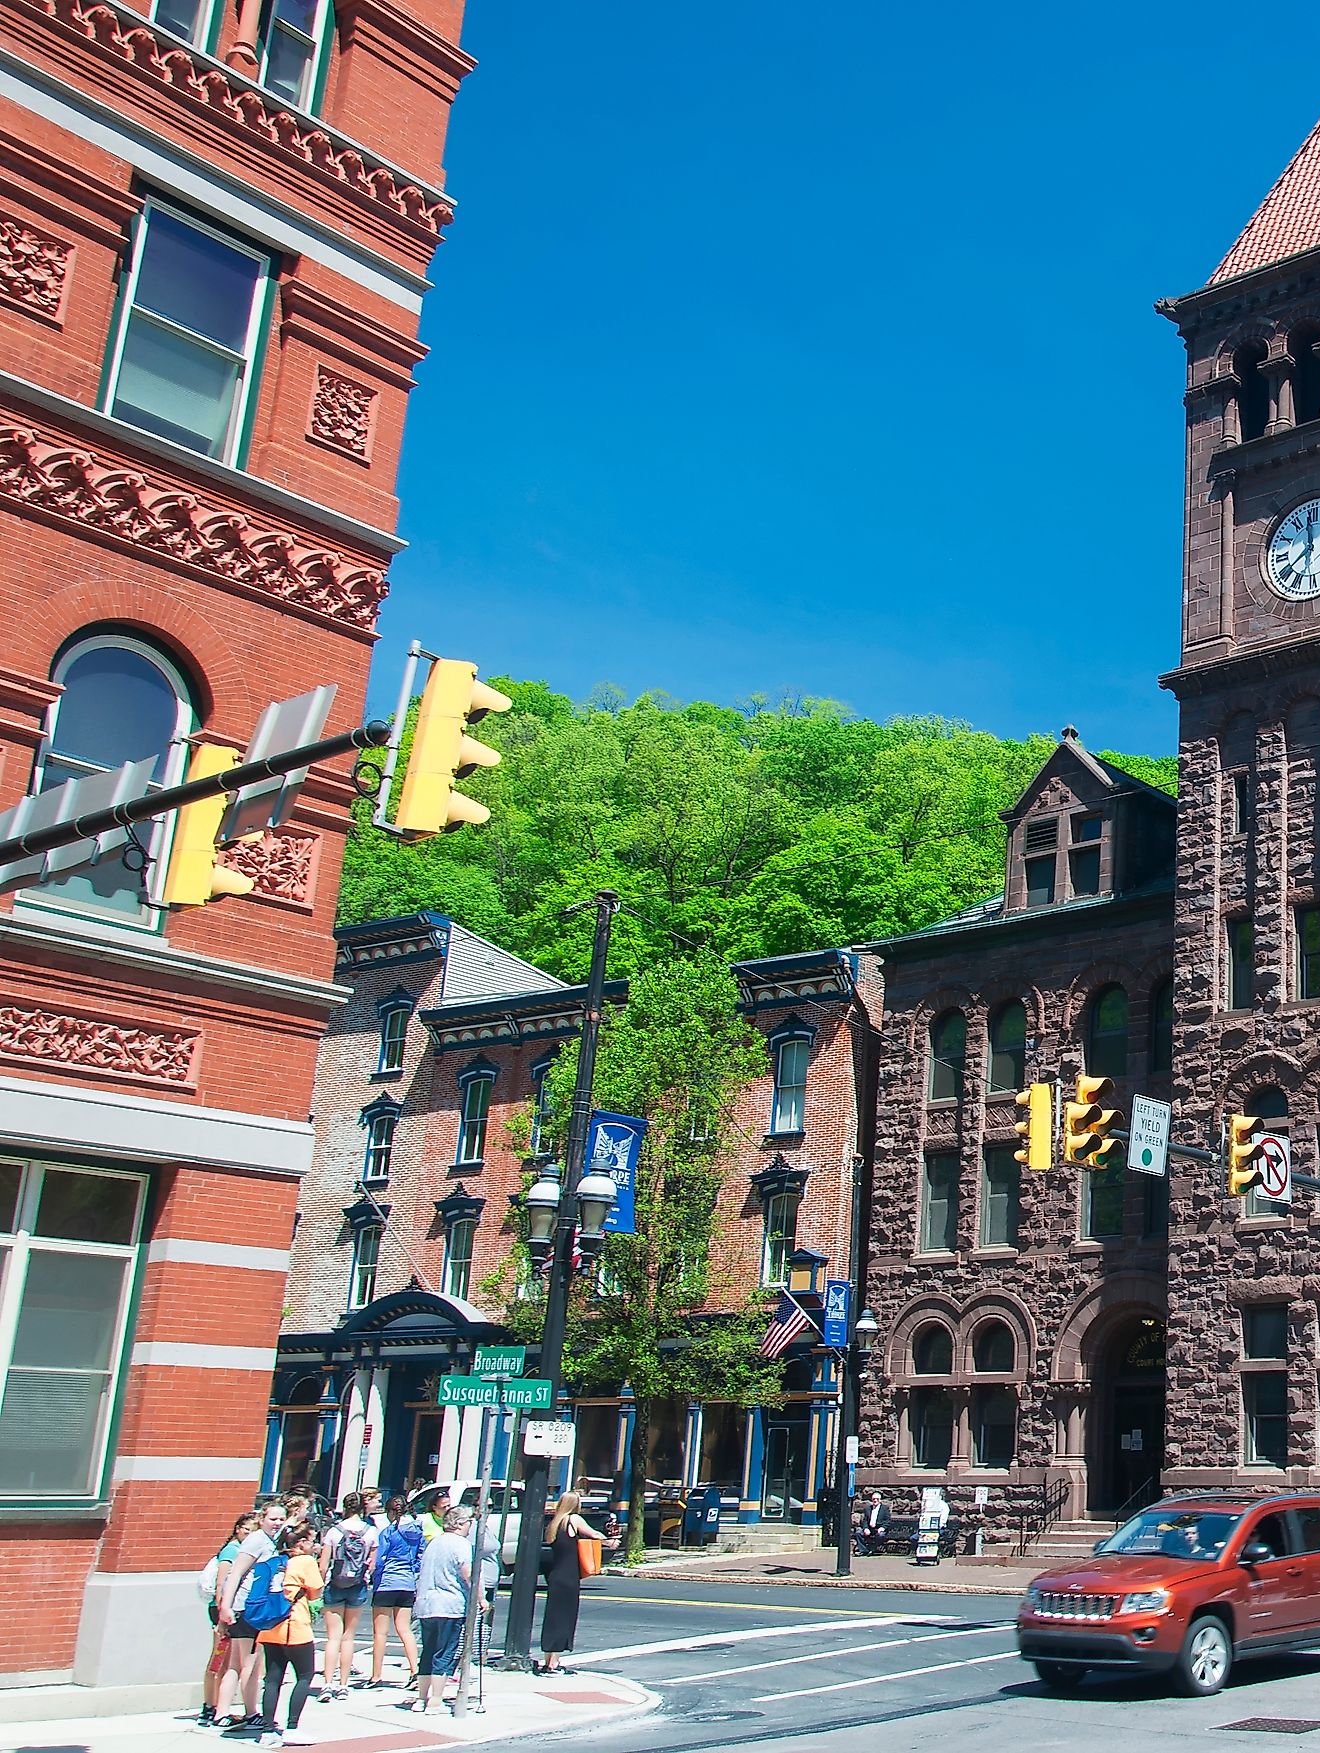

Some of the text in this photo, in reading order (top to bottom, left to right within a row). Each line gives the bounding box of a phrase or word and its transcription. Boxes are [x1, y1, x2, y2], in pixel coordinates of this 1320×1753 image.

[1137, 1102, 1167, 1119] LEFT TURN
[1141, 1118, 1160, 1133] YIELD
[1134, 1131, 1163, 1147] ON GREEN
[473, 1350, 523, 1374] Broadway
[442, 1379, 548, 1403] Susquehanna ST
[548, 1422, 572, 1432] 0209
